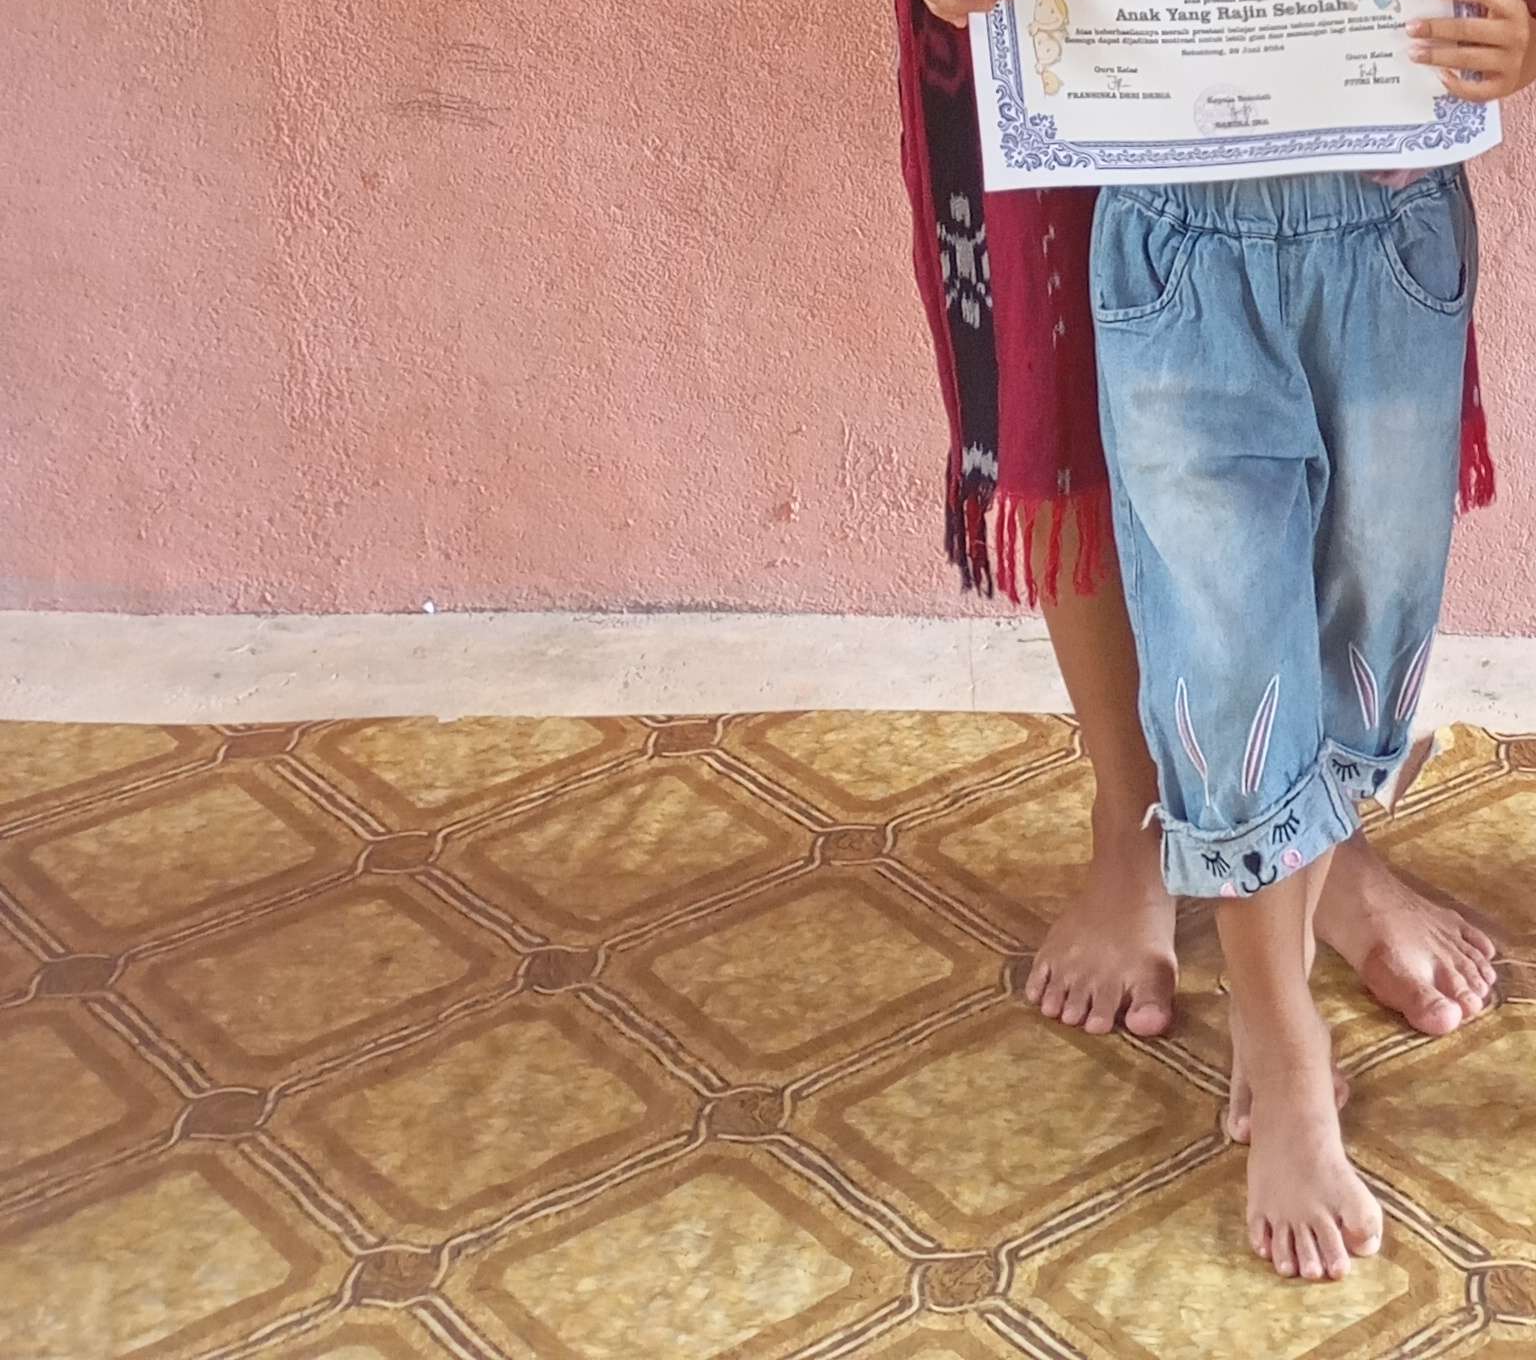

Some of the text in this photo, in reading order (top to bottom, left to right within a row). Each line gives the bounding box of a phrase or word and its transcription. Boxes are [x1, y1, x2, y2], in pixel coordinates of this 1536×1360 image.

[1116, 8, 1161, 22] Anak
[1165, 8, 1211, 24] Yang
[1217, 6, 1268, 22] Rajin
